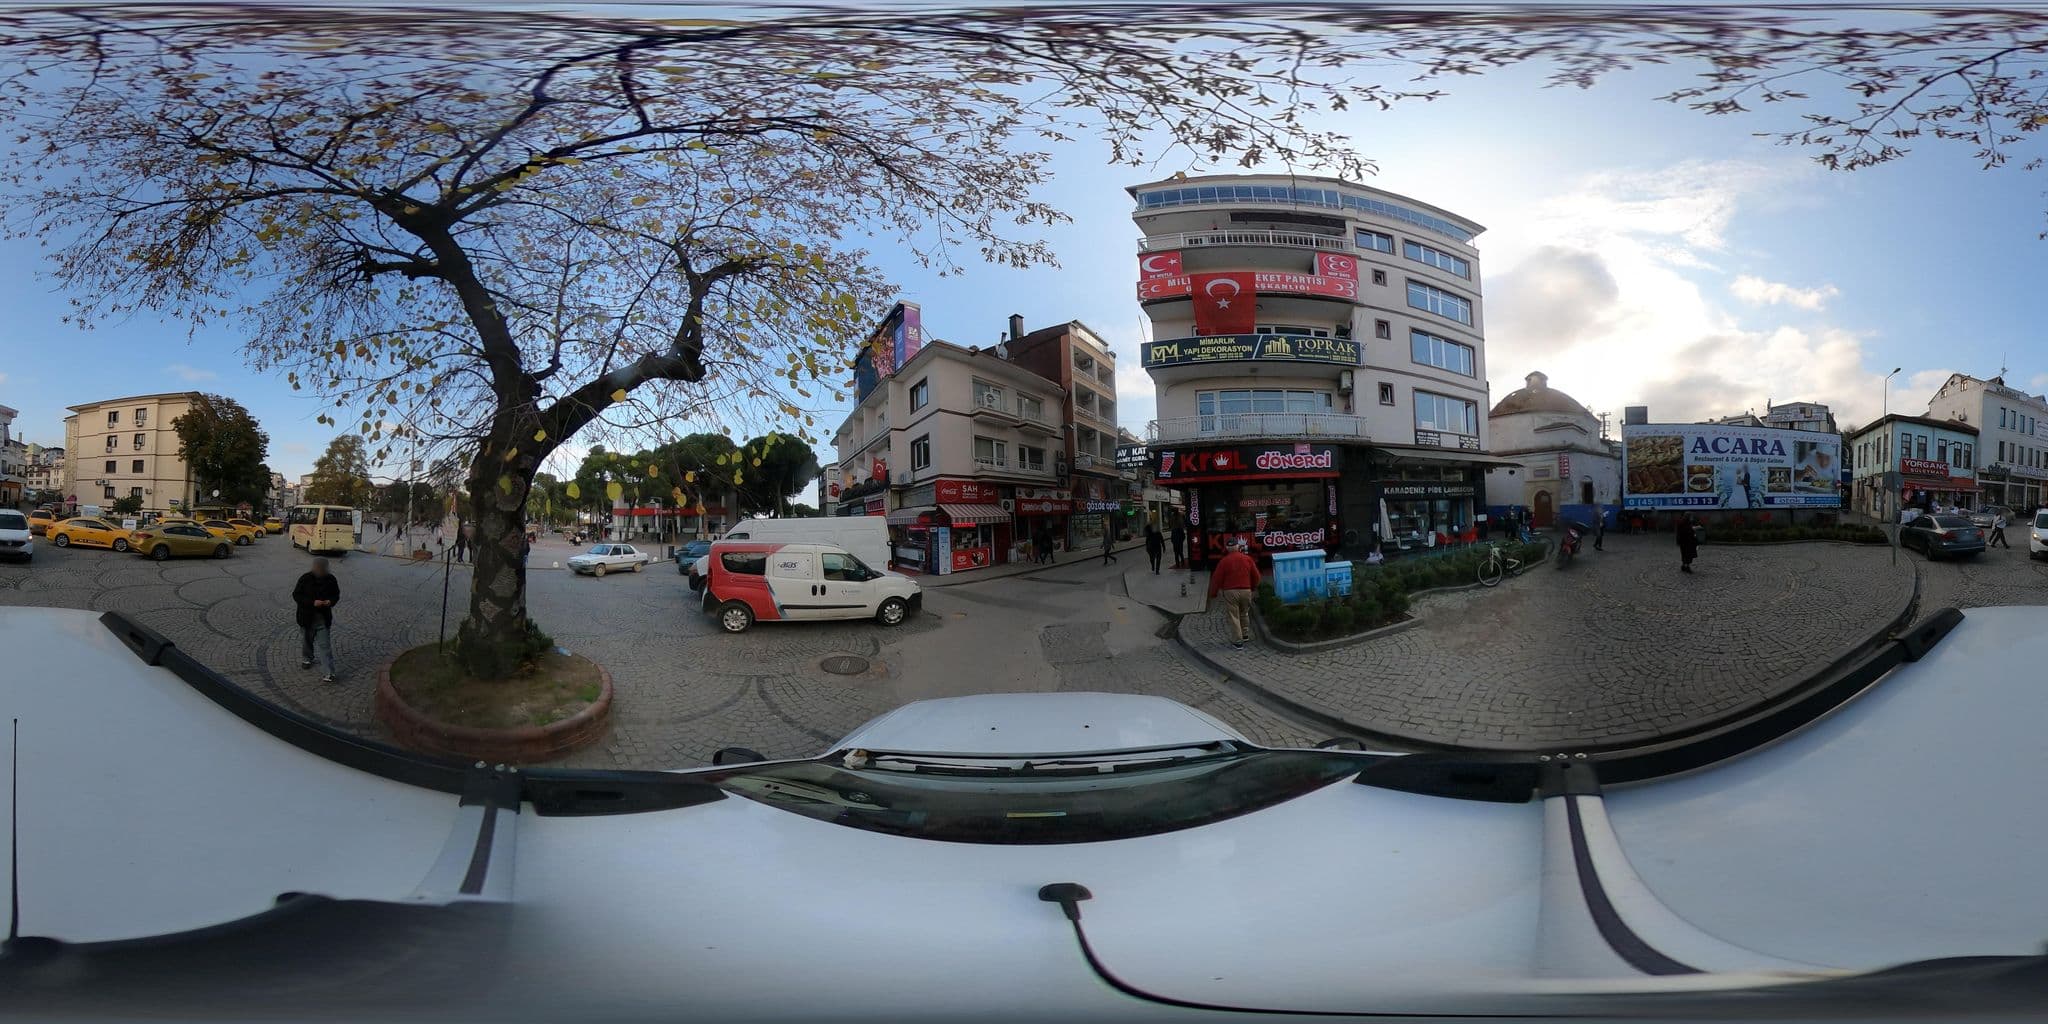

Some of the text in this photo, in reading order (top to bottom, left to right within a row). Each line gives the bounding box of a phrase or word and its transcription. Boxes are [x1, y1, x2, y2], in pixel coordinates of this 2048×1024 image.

[1199, 337, 1236, 345] MİMARLIK
[1295, 339, 1356, 354] TOPRAK
[1201, 345, 1253, 353] DEKORASYON
[1690, 436, 1787, 456] ACARA
